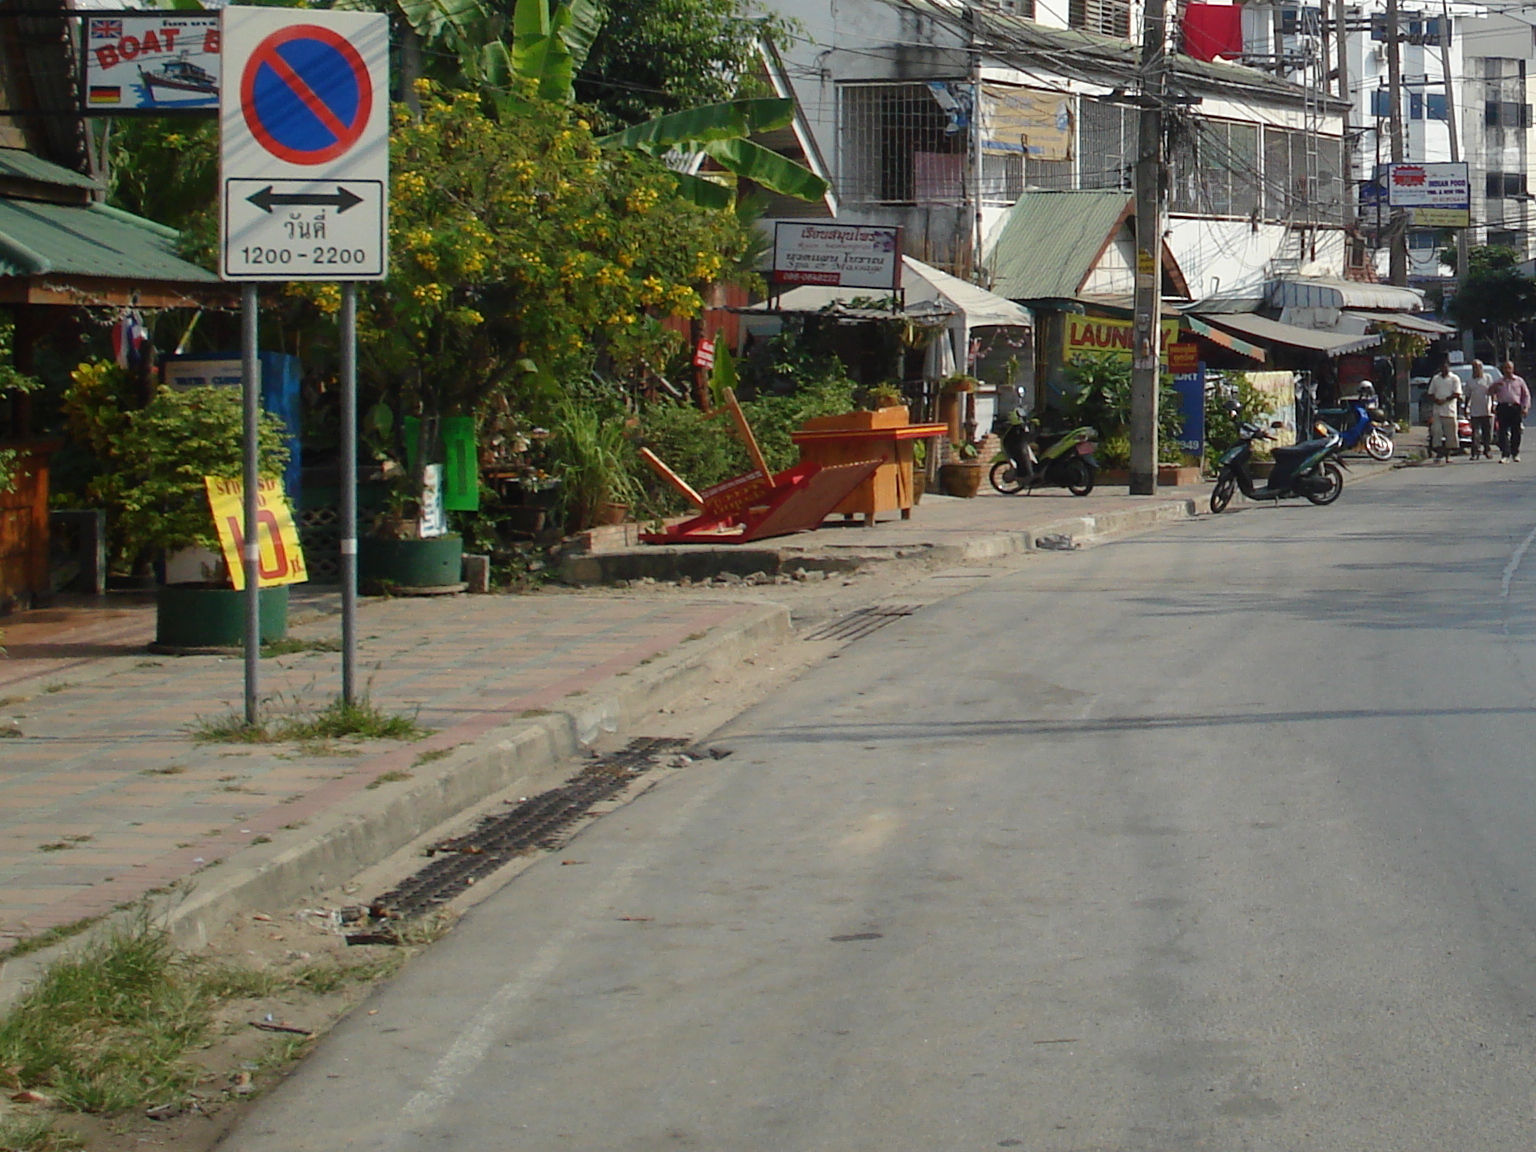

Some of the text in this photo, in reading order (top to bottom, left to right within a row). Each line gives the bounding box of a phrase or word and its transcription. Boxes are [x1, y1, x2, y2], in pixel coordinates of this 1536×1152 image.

[95, 28, 180, 71] BOAT
[283, 208, 326, 239] วันคี่
[241, 246, 292, 264] 1200
[312, 246, 365, 264] 2200
[786, 261, 809, 271] Spa
[832, 263, 882, 273] Massage
[1069, 321, 1172, 351] LAUNY
